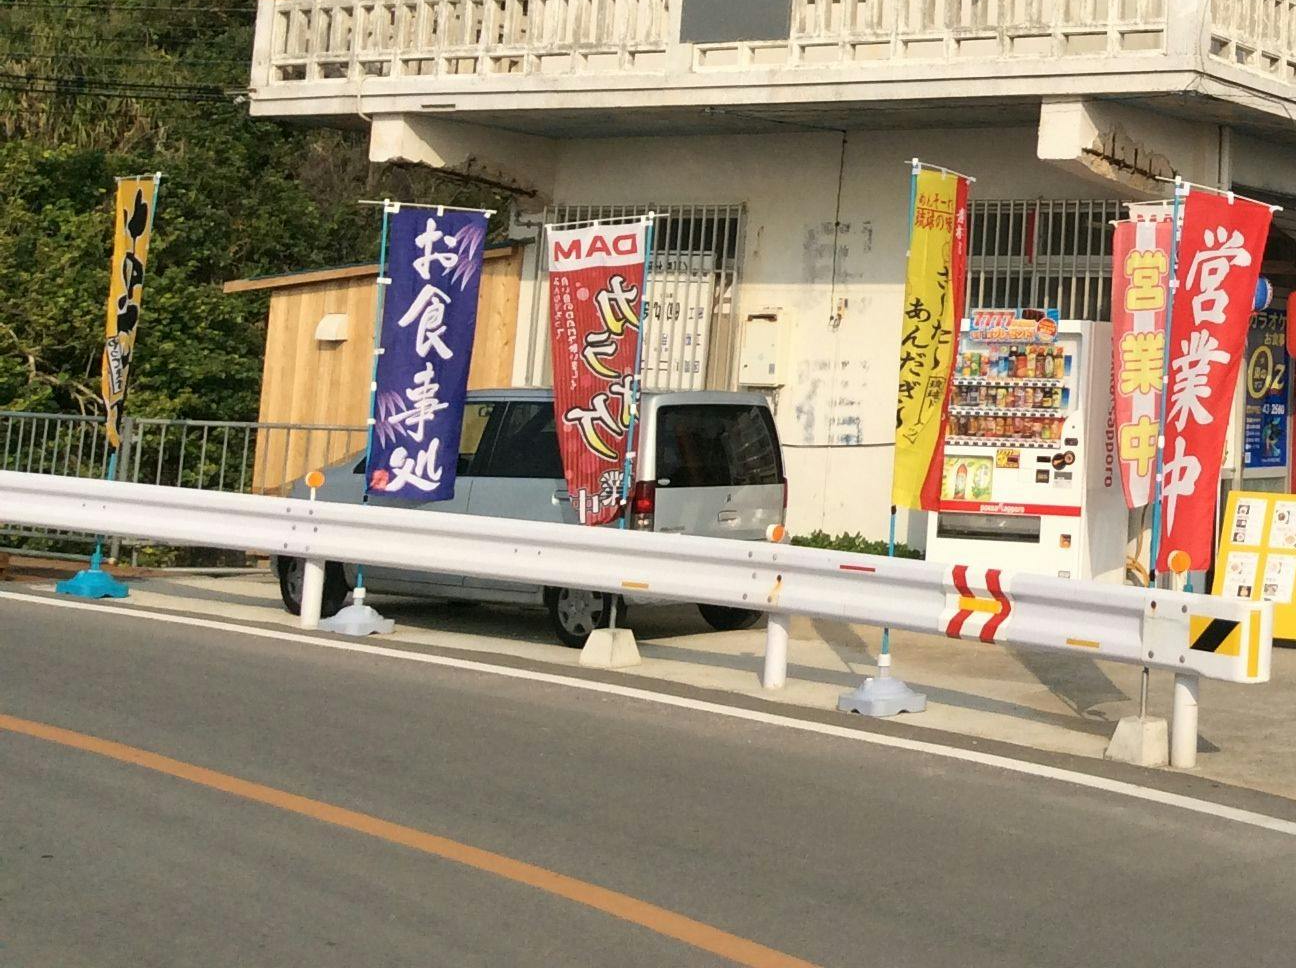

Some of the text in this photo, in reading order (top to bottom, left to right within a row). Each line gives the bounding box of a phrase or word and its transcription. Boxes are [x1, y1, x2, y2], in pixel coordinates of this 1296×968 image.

[385, 217, 458, 492] お食事処
[1118, 249, 1168, 478] 営業中
[1162, 226, 1252, 537] 営業中
